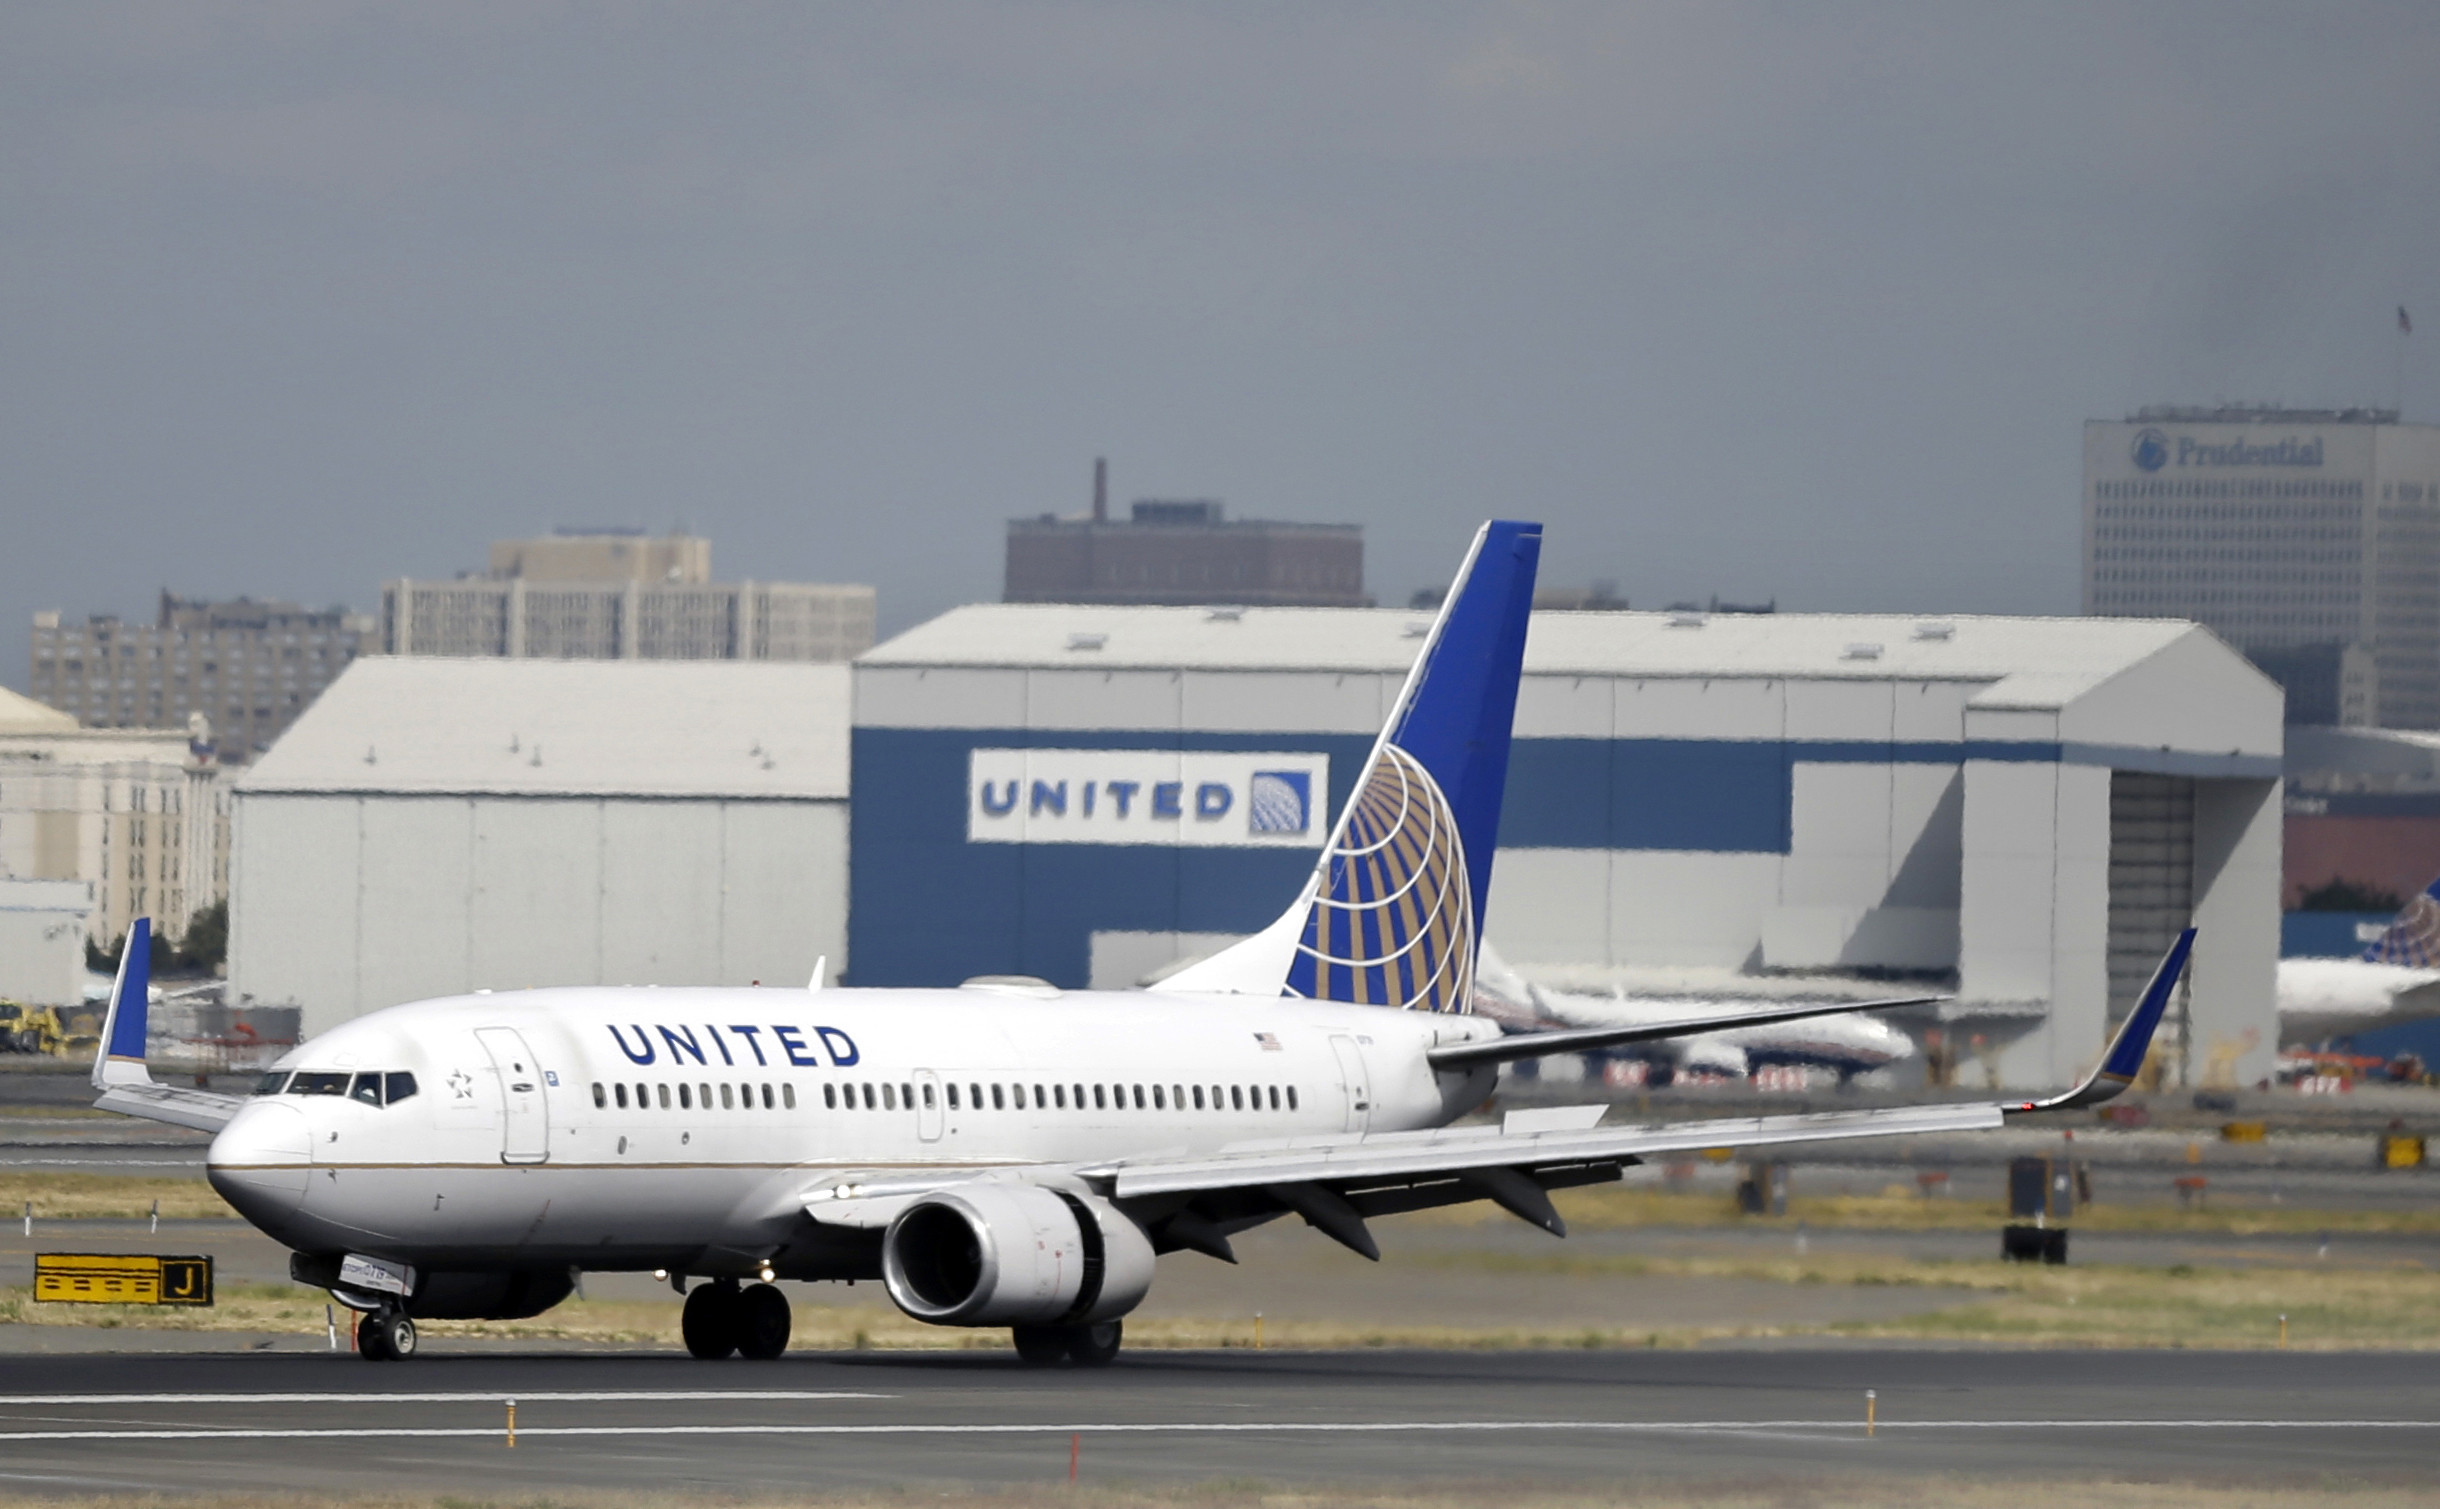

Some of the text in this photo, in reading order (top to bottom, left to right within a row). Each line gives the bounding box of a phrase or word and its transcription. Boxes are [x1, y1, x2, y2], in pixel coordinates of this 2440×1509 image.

[2177, 436, 2324, 466] Prudential
[981, 779, 1235, 820] UNITED
[605, 1024, 860, 1067] UNITED
[174, 1266, 193, 1296] J
